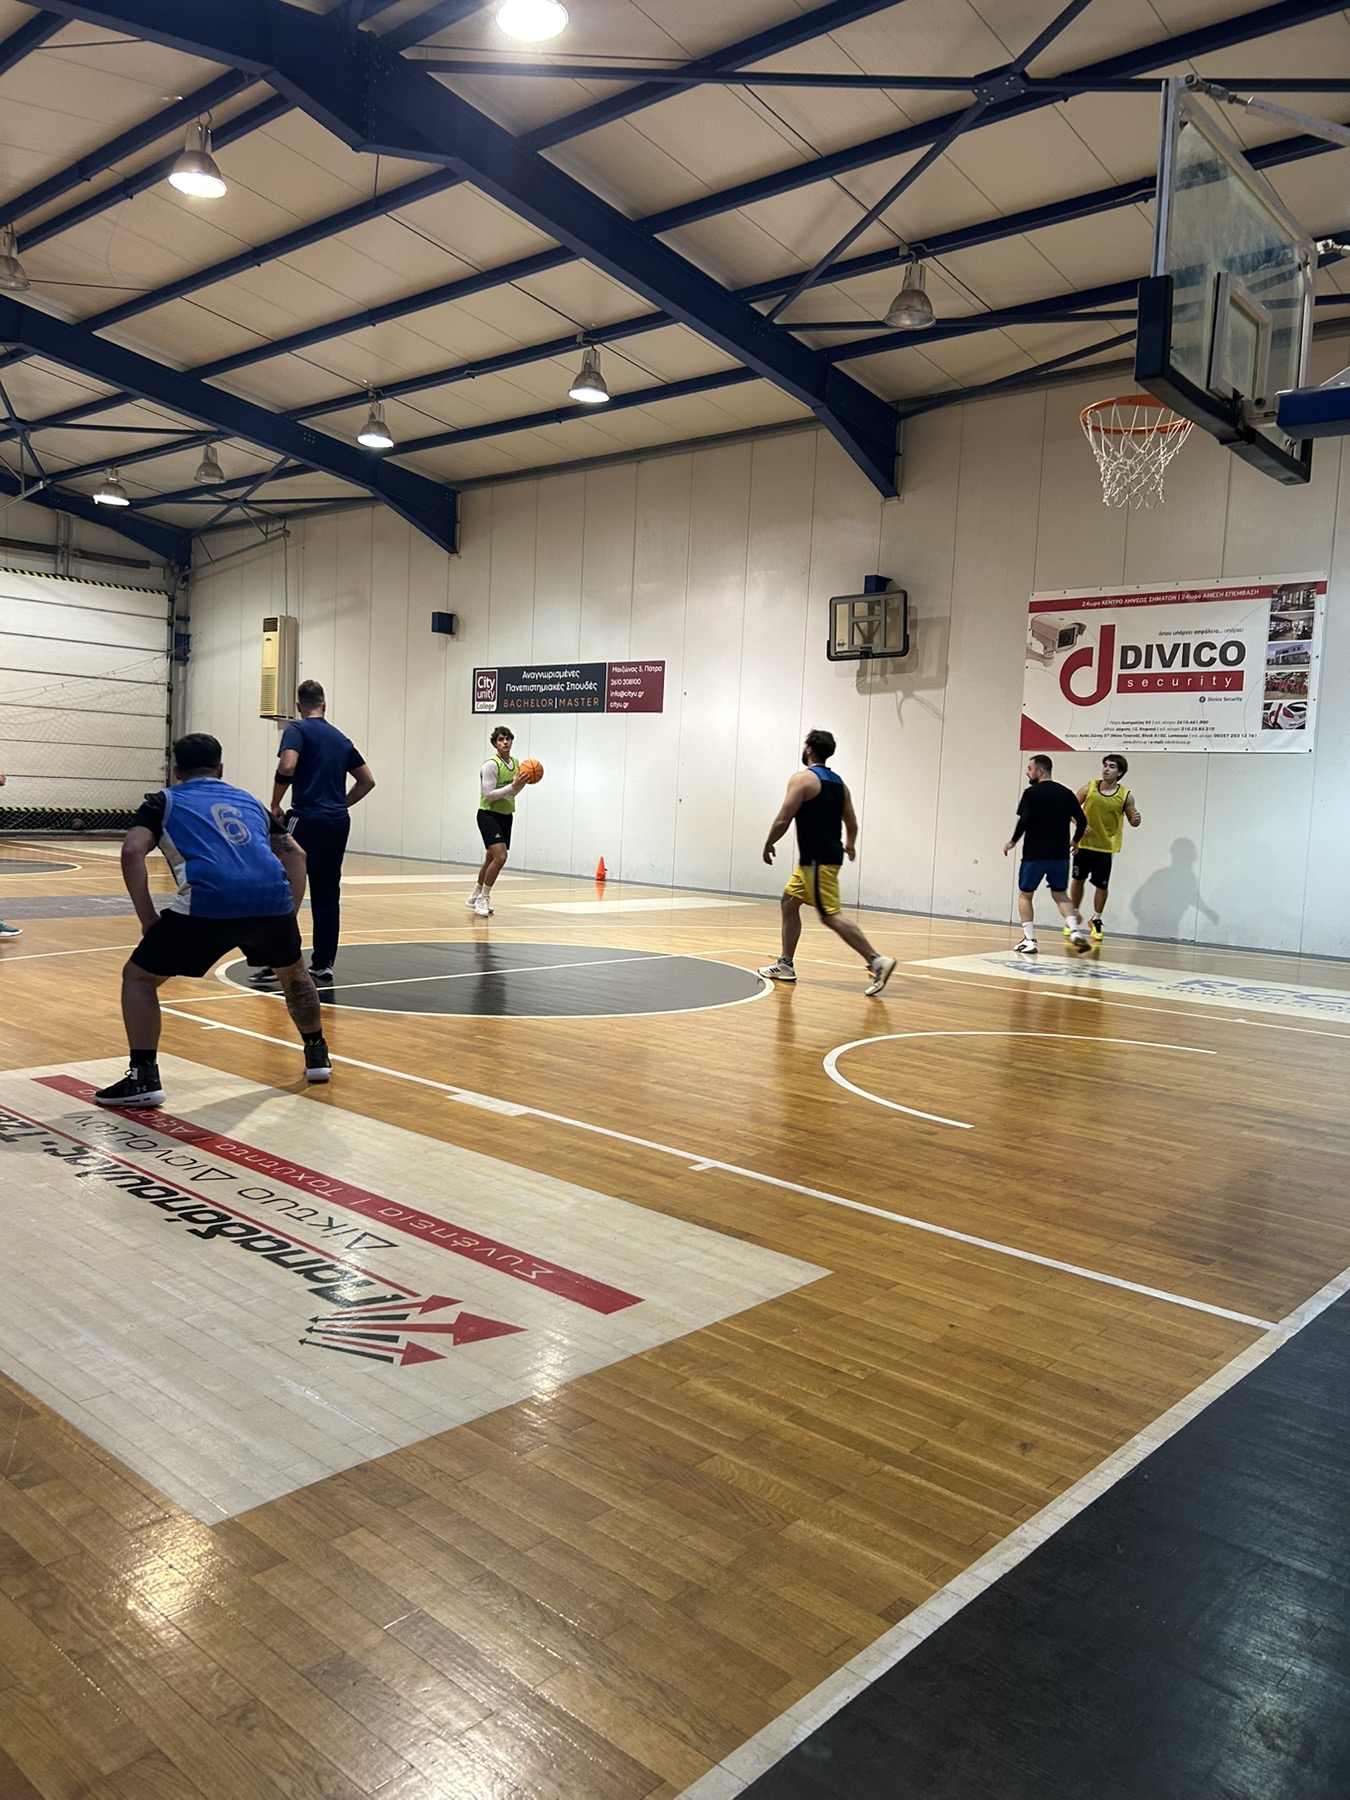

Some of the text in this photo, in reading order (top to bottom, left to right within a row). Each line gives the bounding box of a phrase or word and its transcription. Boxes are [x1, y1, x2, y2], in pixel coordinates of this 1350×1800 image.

[1102, 598, 1124, 606] ΚΕΝΤΡΟ
[1148, 595, 1177, 603] ΣΗΜΑΤΩΝ
[1225, 589, 1260, 597] ΕΠΕΜΒΑΣΗ
[1120, 640, 1246, 670] DIVICO
[477, 675, 496, 691] City
[522, 669, 581, 680] Αναγνωρισμένες
[1127, 675, 1232, 688] security
[476, 689, 496, 701] unity
[505, 681, 598, 693] Πανεπιστημιακές Σπουδές
[210, 803, 252, 846] 6
[215, 1143, 344, 1197] Ταχύτητα
[63, 1115, 400, 1251] Δίκτυο Διανομών
[377, 1206, 555, 1280] Συνέπεια
